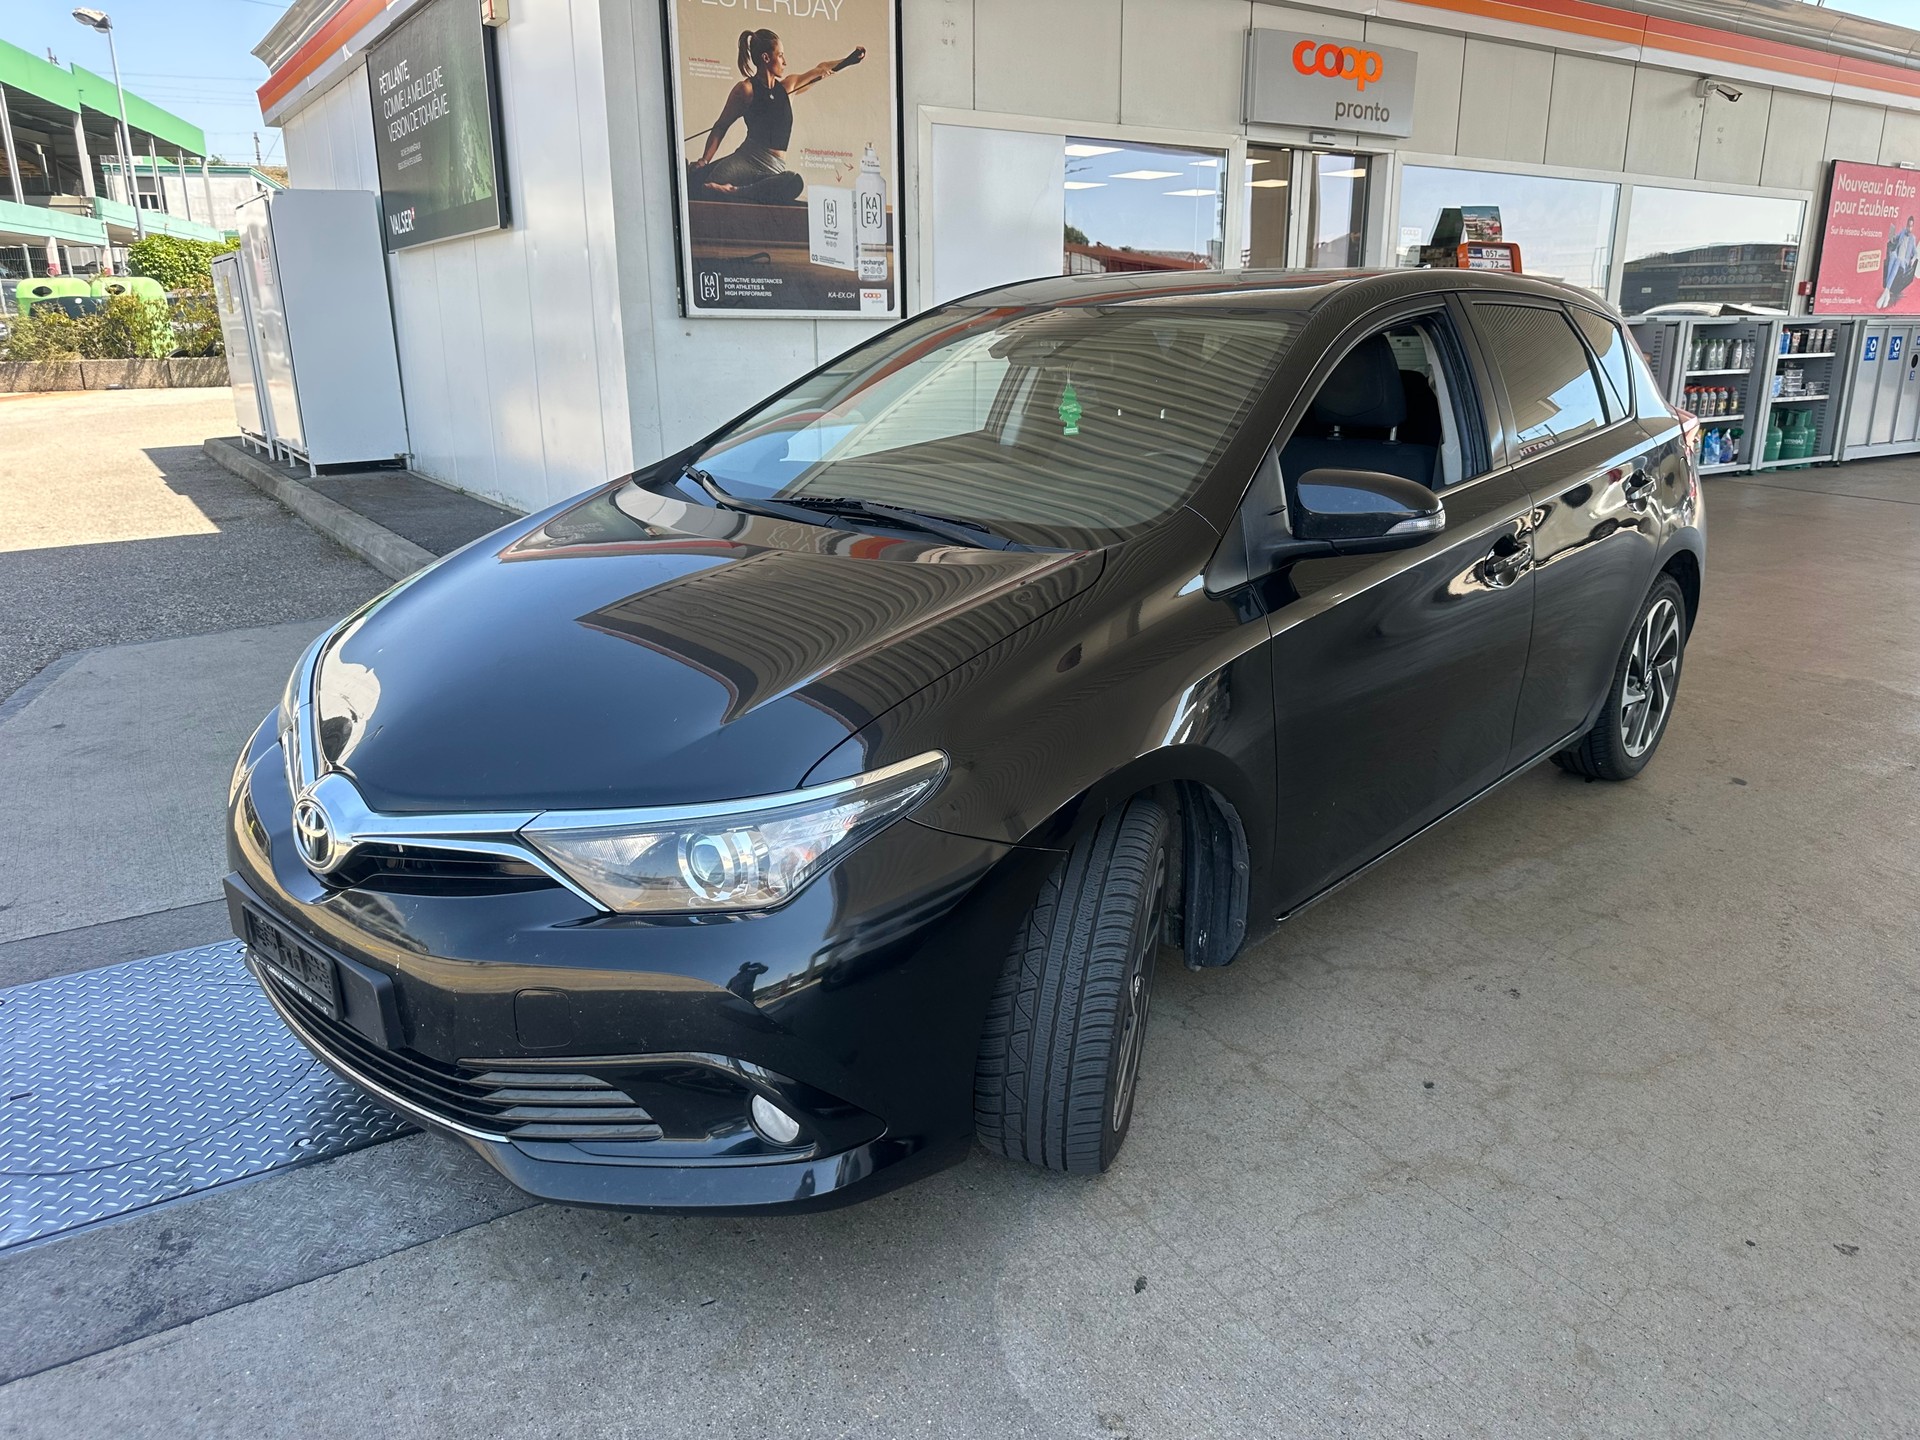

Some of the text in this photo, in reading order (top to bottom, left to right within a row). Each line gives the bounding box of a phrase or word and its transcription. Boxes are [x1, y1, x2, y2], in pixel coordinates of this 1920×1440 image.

[687, 0, 843, 21] ERDAY
[1292, 39, 1383, 92] coop
[383, 66, 443, 120] COMME LA MEILLEURE
[1335, 100, 1390, 122] pronto
[388, 114, 411, 142] VERSION
[410, 109, 420, 132] DE
[1837, 173, 1916, 198] Nouveau: la fibre
[866, 196, 878, 210] KA
[1833, 198, 1899, 218] pour Ecublens
[389, 209, 414, 235] VALSER
[866, 211, 878, 225] EX
[1830, 225, 1839, 235] Sur
[860, 259, 884, 267] recharge
[704, 275, 715, 286] KA
[705, 287, 716, 298] EX
